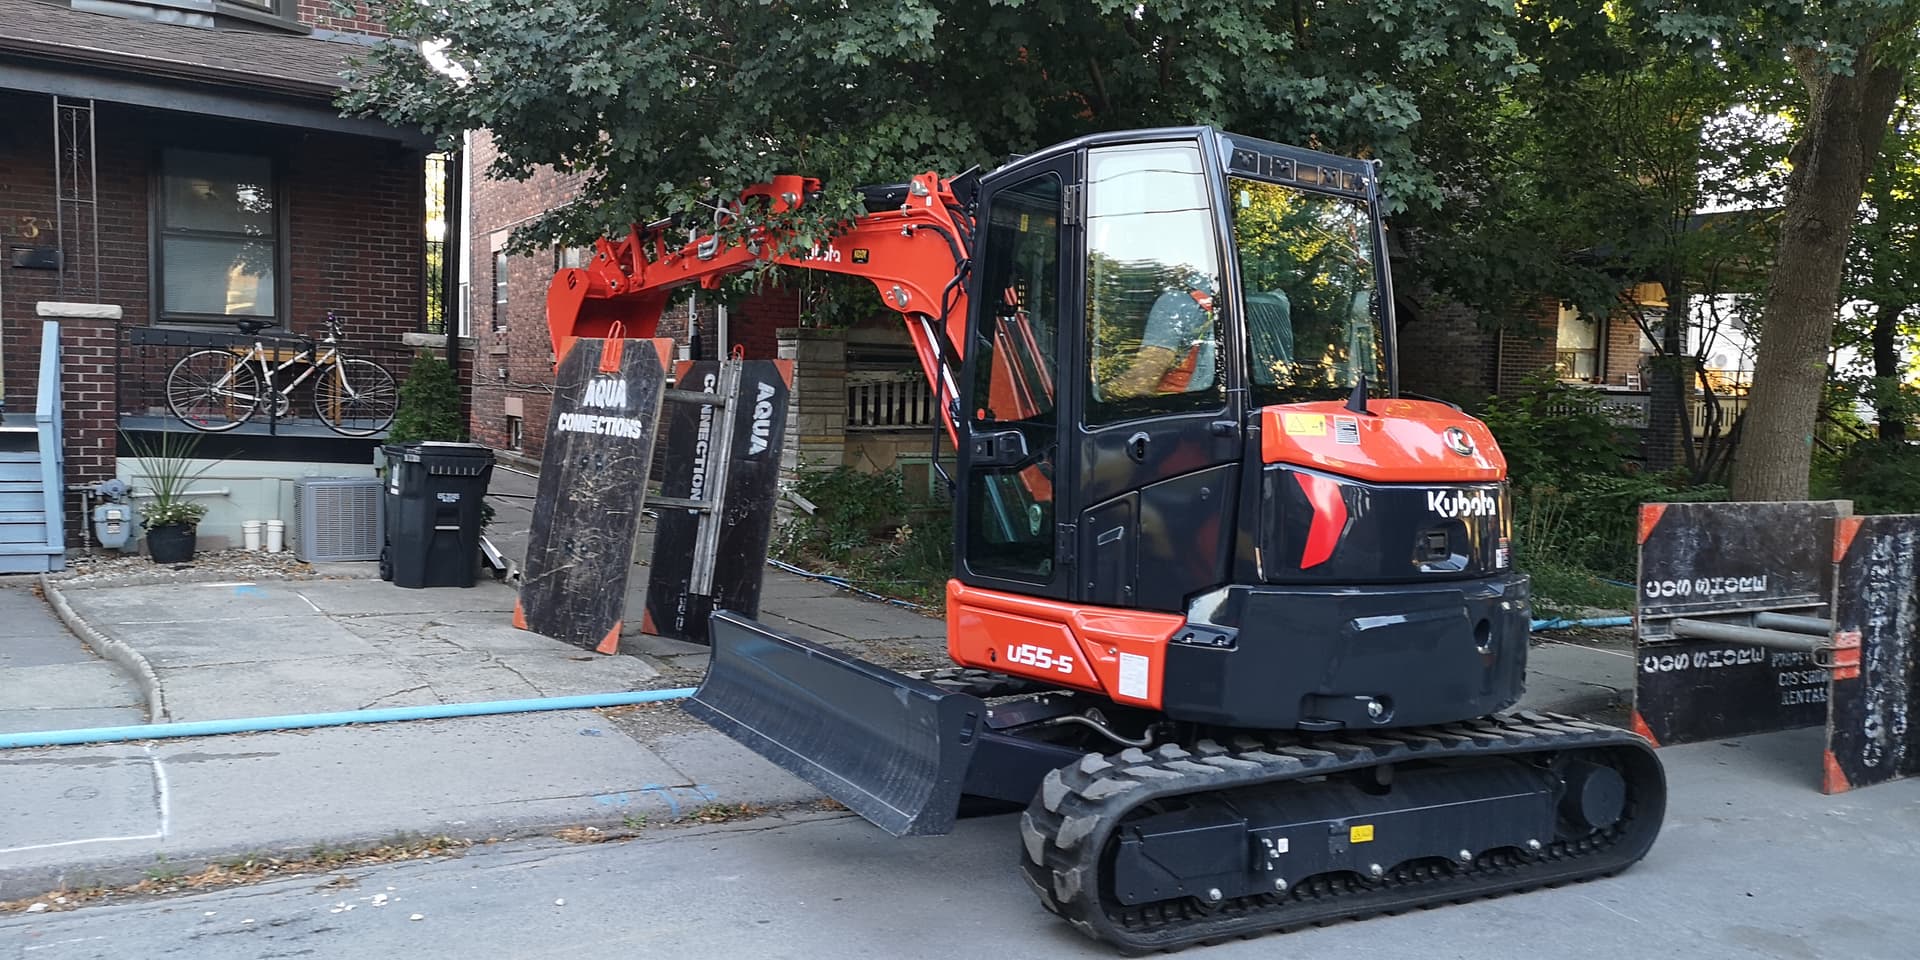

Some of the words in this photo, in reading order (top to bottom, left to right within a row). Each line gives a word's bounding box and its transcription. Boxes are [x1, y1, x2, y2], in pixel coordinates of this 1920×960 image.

[583, 380, 626, 408] AQUA
[558, 413, 642, 439] CONNECTIONS
[748, 381, 775, 456] AQUA
[1427, 490, 1496, 518] Kubota
[1646, 579, 1692, 598] COS
[1695, 575, 1767, 595] SHORE
[1007, 644, 1073, 674] U55-5
[1643, 653, 1690, 673] COS
[1693, 647, 1765, 668] SHORE
